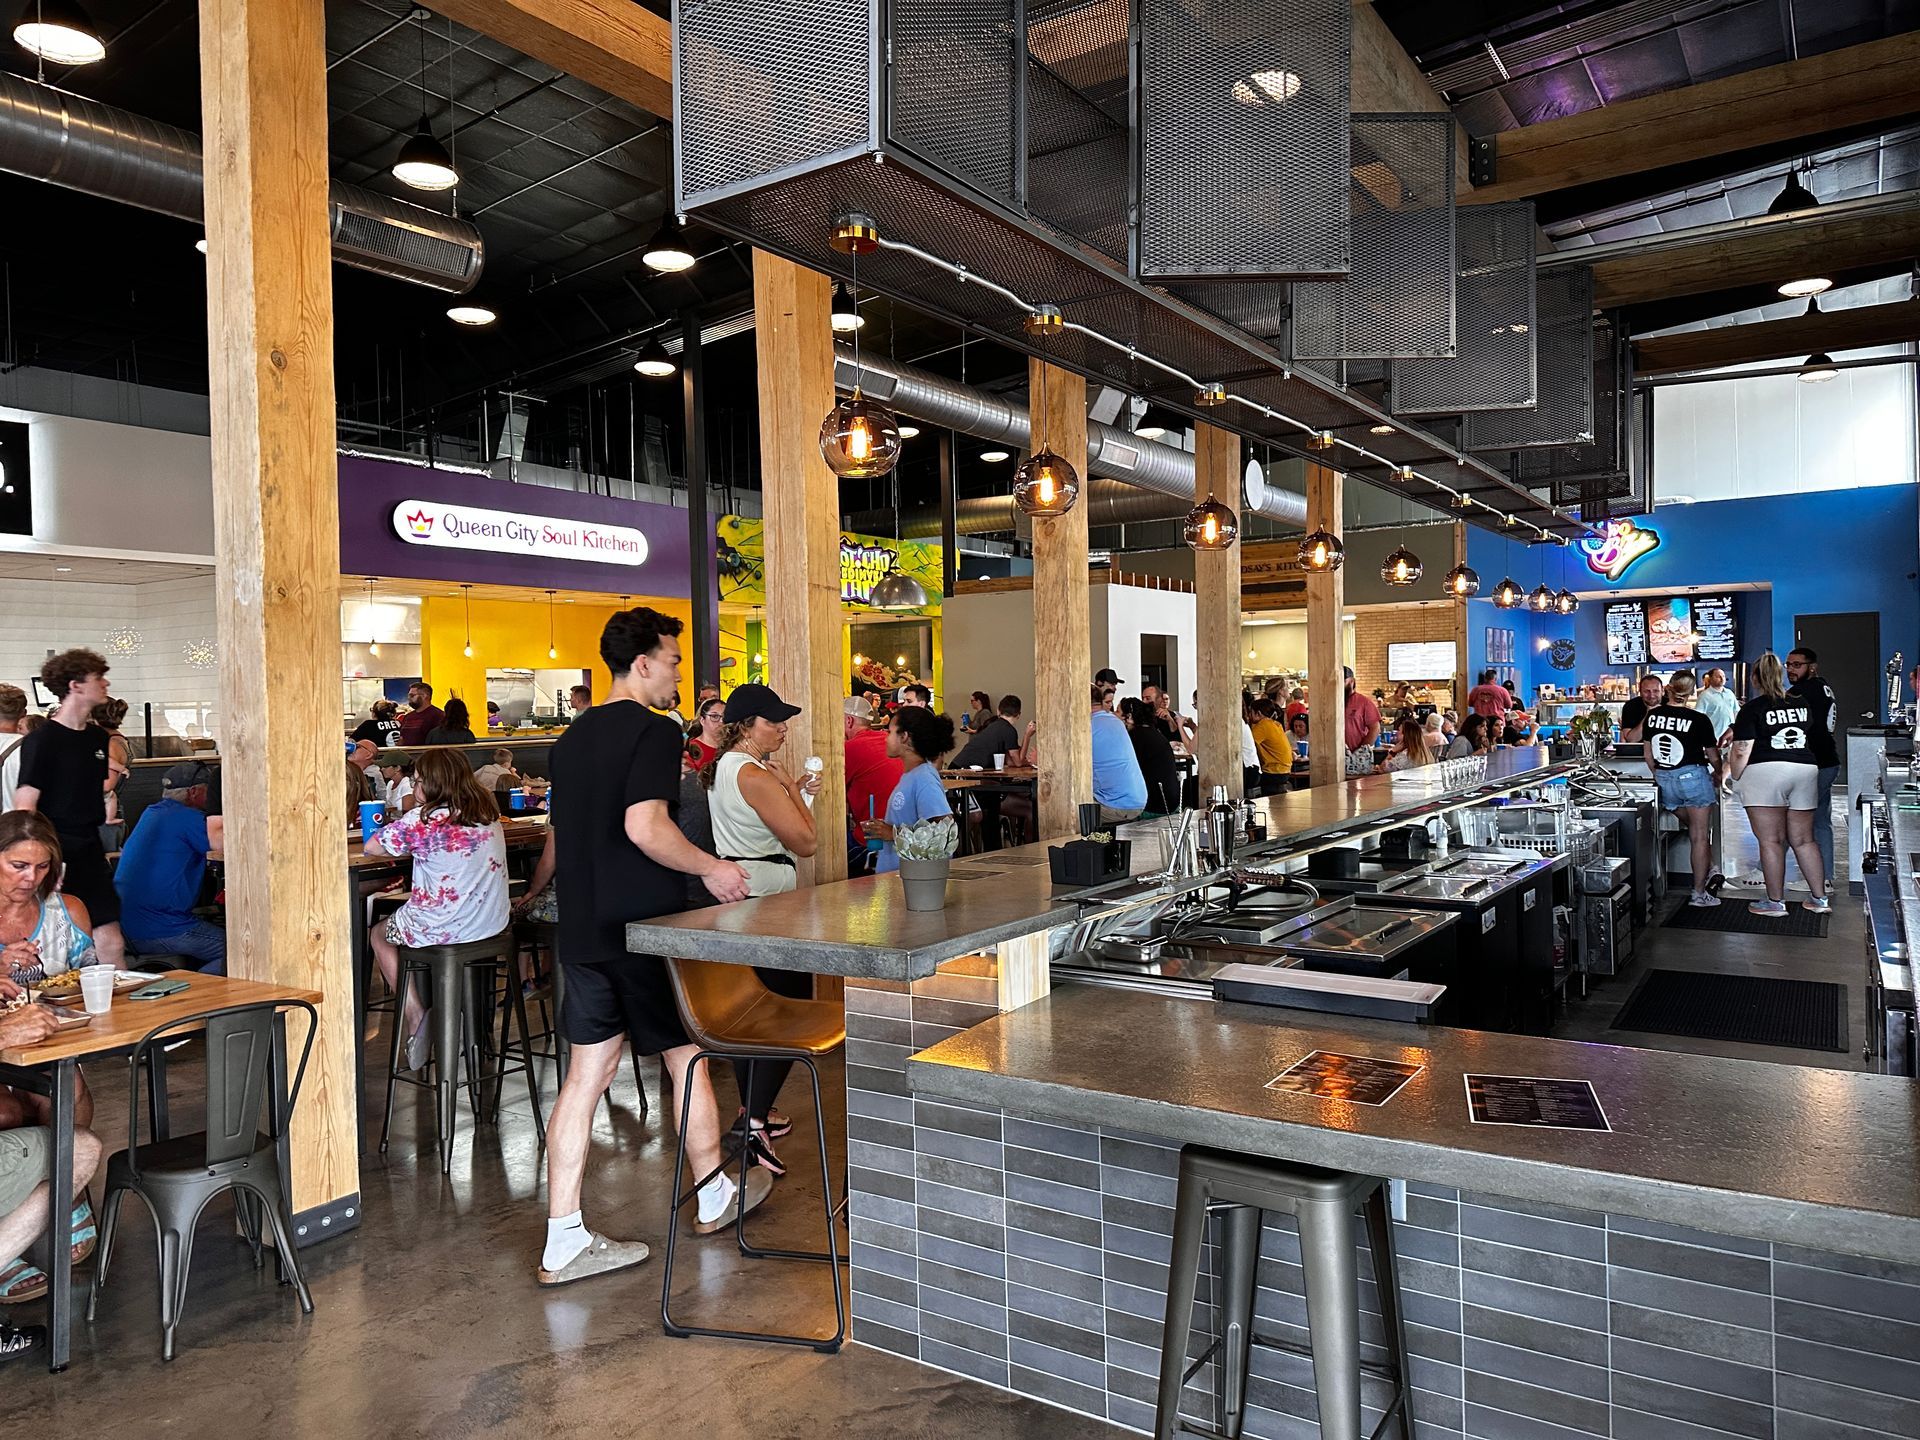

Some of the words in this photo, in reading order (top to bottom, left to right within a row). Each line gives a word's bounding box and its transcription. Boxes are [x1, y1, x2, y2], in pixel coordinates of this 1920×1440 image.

[443, 513, 502, 538] Queen
[506, 520, 539, 546] City
[542, 525, 577, 546] Soul
[582, 530, 639, 553] Kitchen
[1240, 563, 1272, 574] DSAY'S
[1276, 561, 1301, 571] KITC
[1648, 714, 1692, 733] CREW
[1766, 708, 1808, 726] CREW
